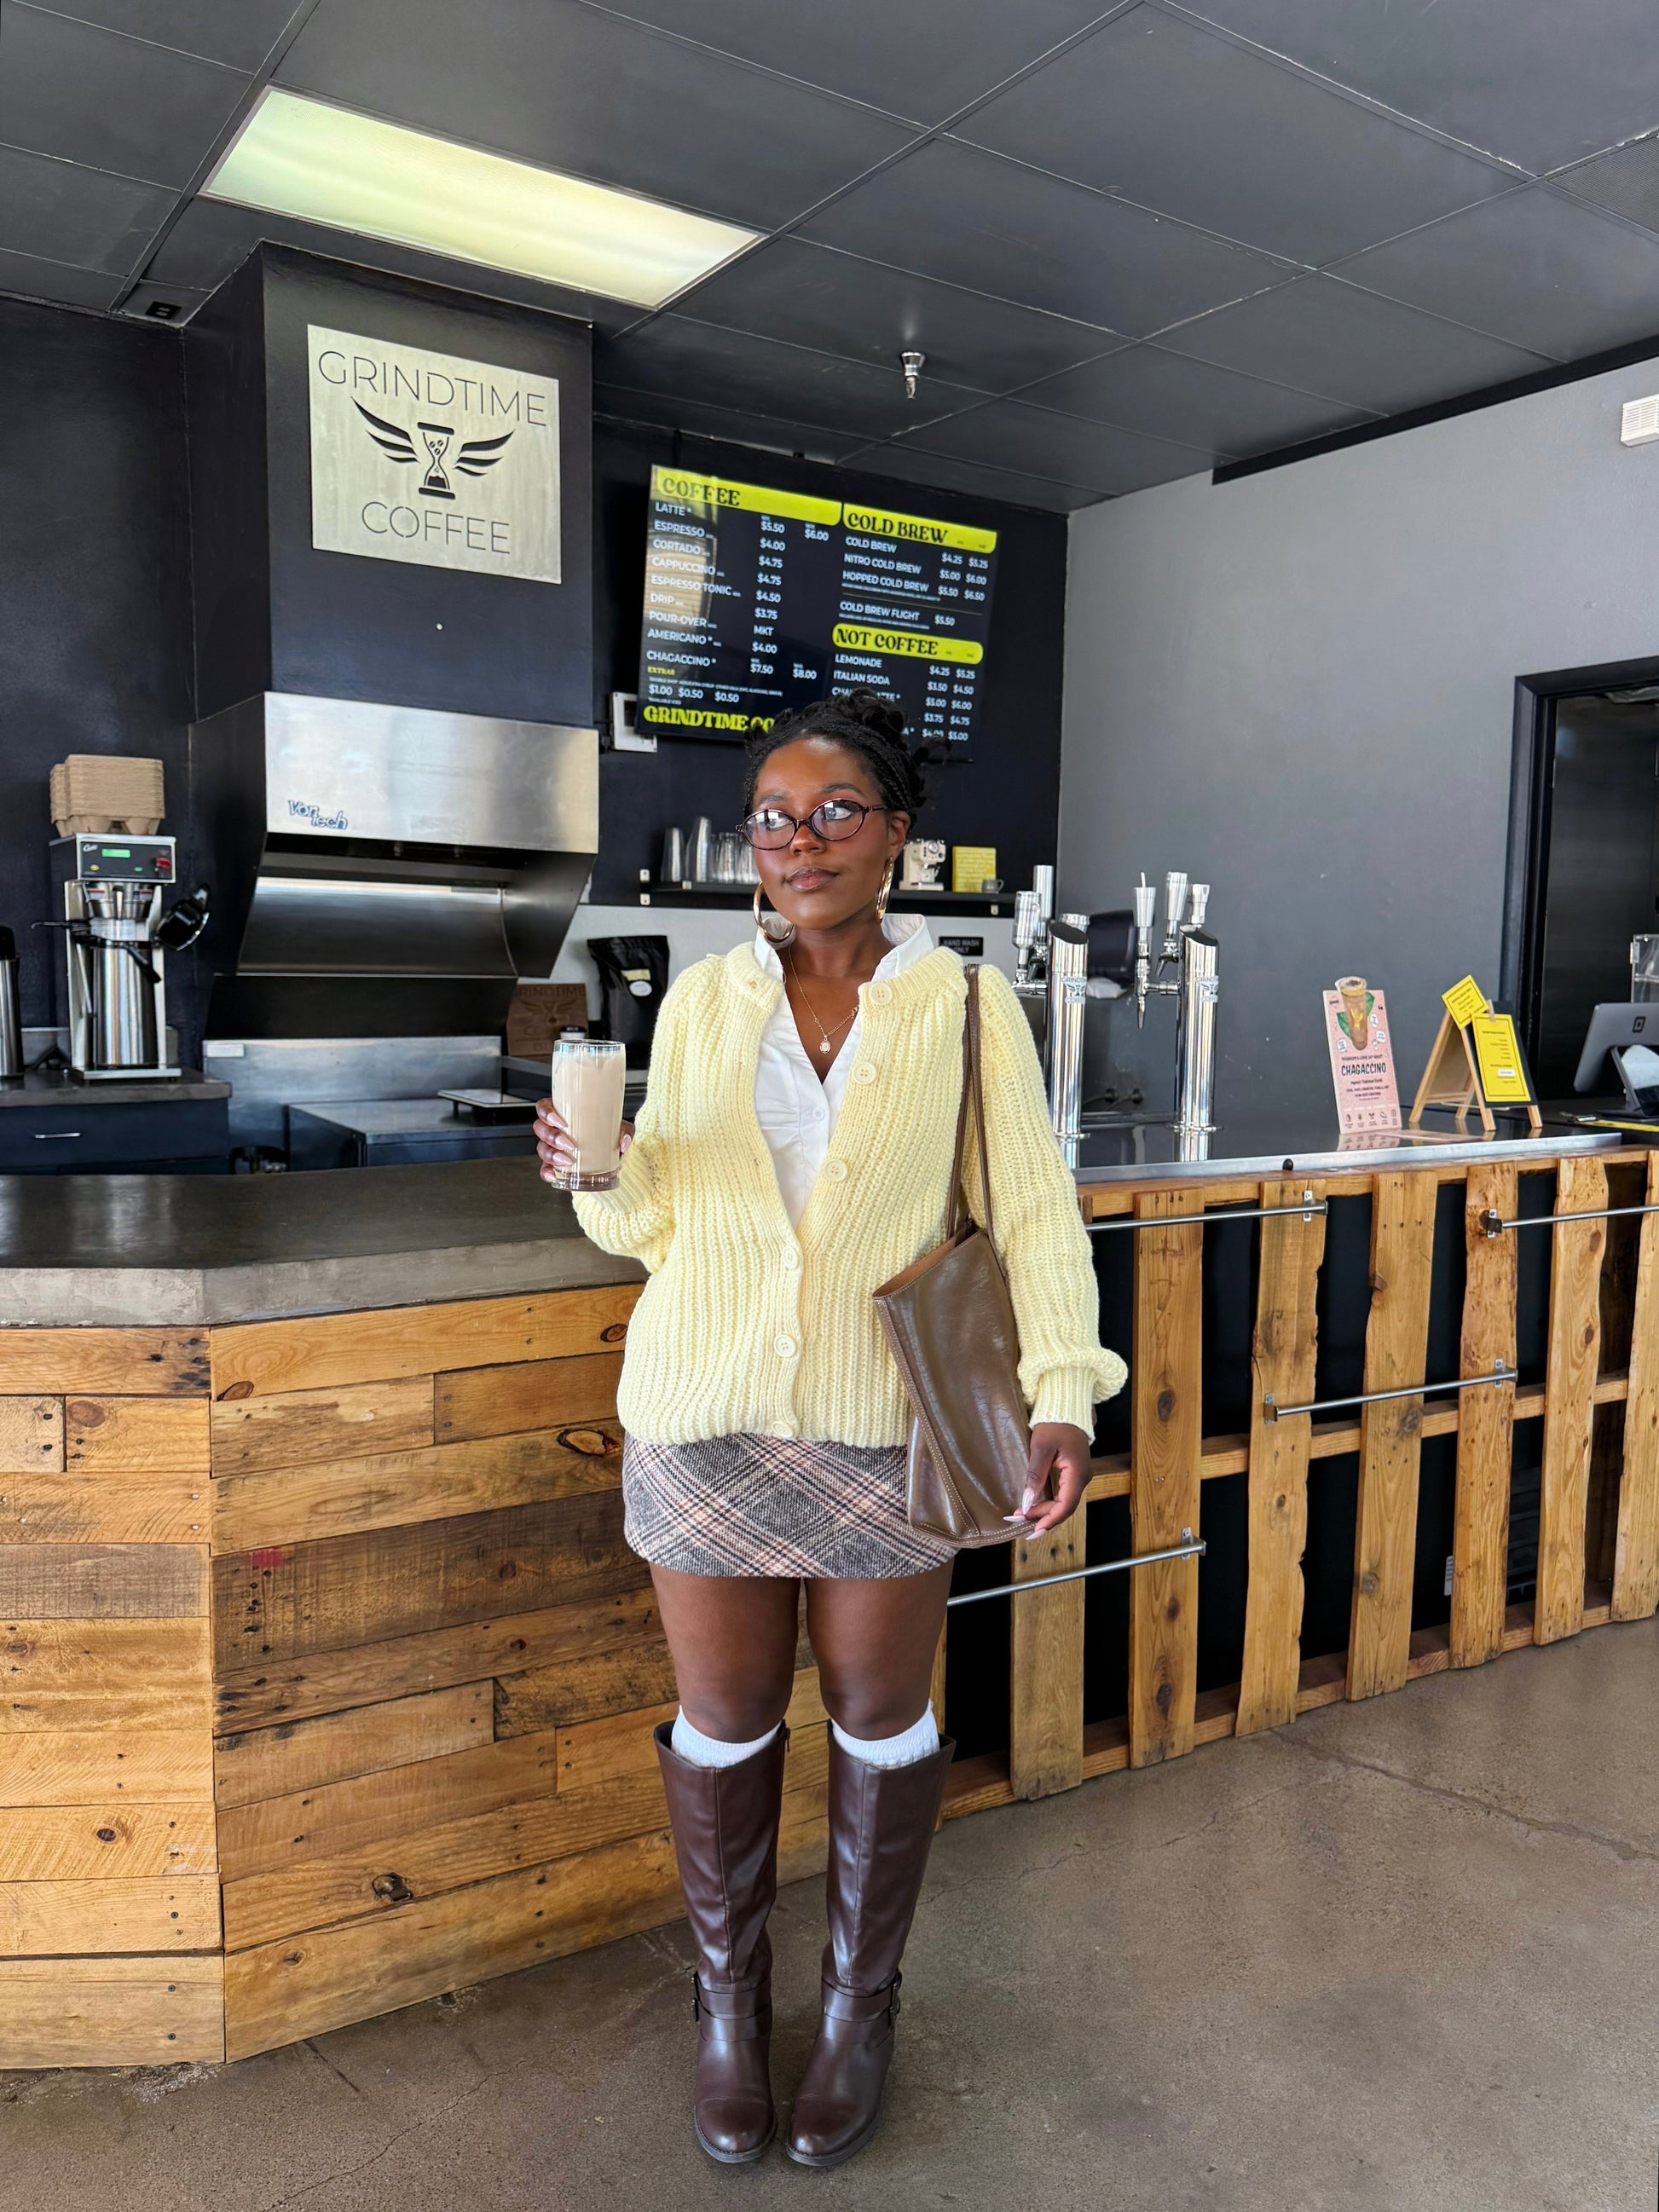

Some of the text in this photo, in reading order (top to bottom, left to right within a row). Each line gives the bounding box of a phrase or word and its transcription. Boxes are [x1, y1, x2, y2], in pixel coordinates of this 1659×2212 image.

[319, 350, 546, 427] GRINDTIME
[662, 477, 741, 507] COFFEE
[361, 501, 511, 555] COFFEE
[655, 501, 830, 541] LATTE $5.50 $6.00
[847, 513, 949, 544] COLD BREW
[654, 520, 786, 552] ESPRESSO $4.00
[845, 535, 870, 549] COLD
[870, 540, 898, 553] BREW
[653, 539, 783, 569] CORTADO $4.75
[844, 552, 870, 567] NITRO
[871, 557, 895, 571] COLD
[896, 562, 922, 575] BREW
[652, 557, 782, 586] CAPPUCCINO $4.75
[842, 569, 879, 585] HOPPED
[880, 575, 903, 589] COLD
[904, 580, 930, 592] BREW
[650, 575, 702, 592] ESPRESSO
[702, 582, 732, 596] TONIC
[755, 590, 782, 603] $4.50
[650, 592, 674, 604] DRIP
[754, 607, 778, 620] $3.75
[839, 600, 864, 613] COLD
[864, 604, 891, 617] BREW
[892, 609, 920, 621] FLIGHT
[649, 610, 708, 627] POUR-OVER
[753, 625, 774, 637] MKT
[648, 628, 777, 654] AMERICANO $4.00
[836, 628, 939, 656] NOT COFFEE
[646, 650, 817, 679] CHAGACCINO $7.50 $8.00
[835, 654, 882, 668] LEMONADE
[833, 670, 865, 683] ITALIAN
[866, 673, 890, 685] SODA
[648, 684, 673, 696] $1.00
[678, 686, 704, 699] $0.50
[714, 691, 740, 703] $0.50
[643, 705, 749, 731] GRINDTIME
[1341, 1062, 1387, 1077] CHAGACCINO
